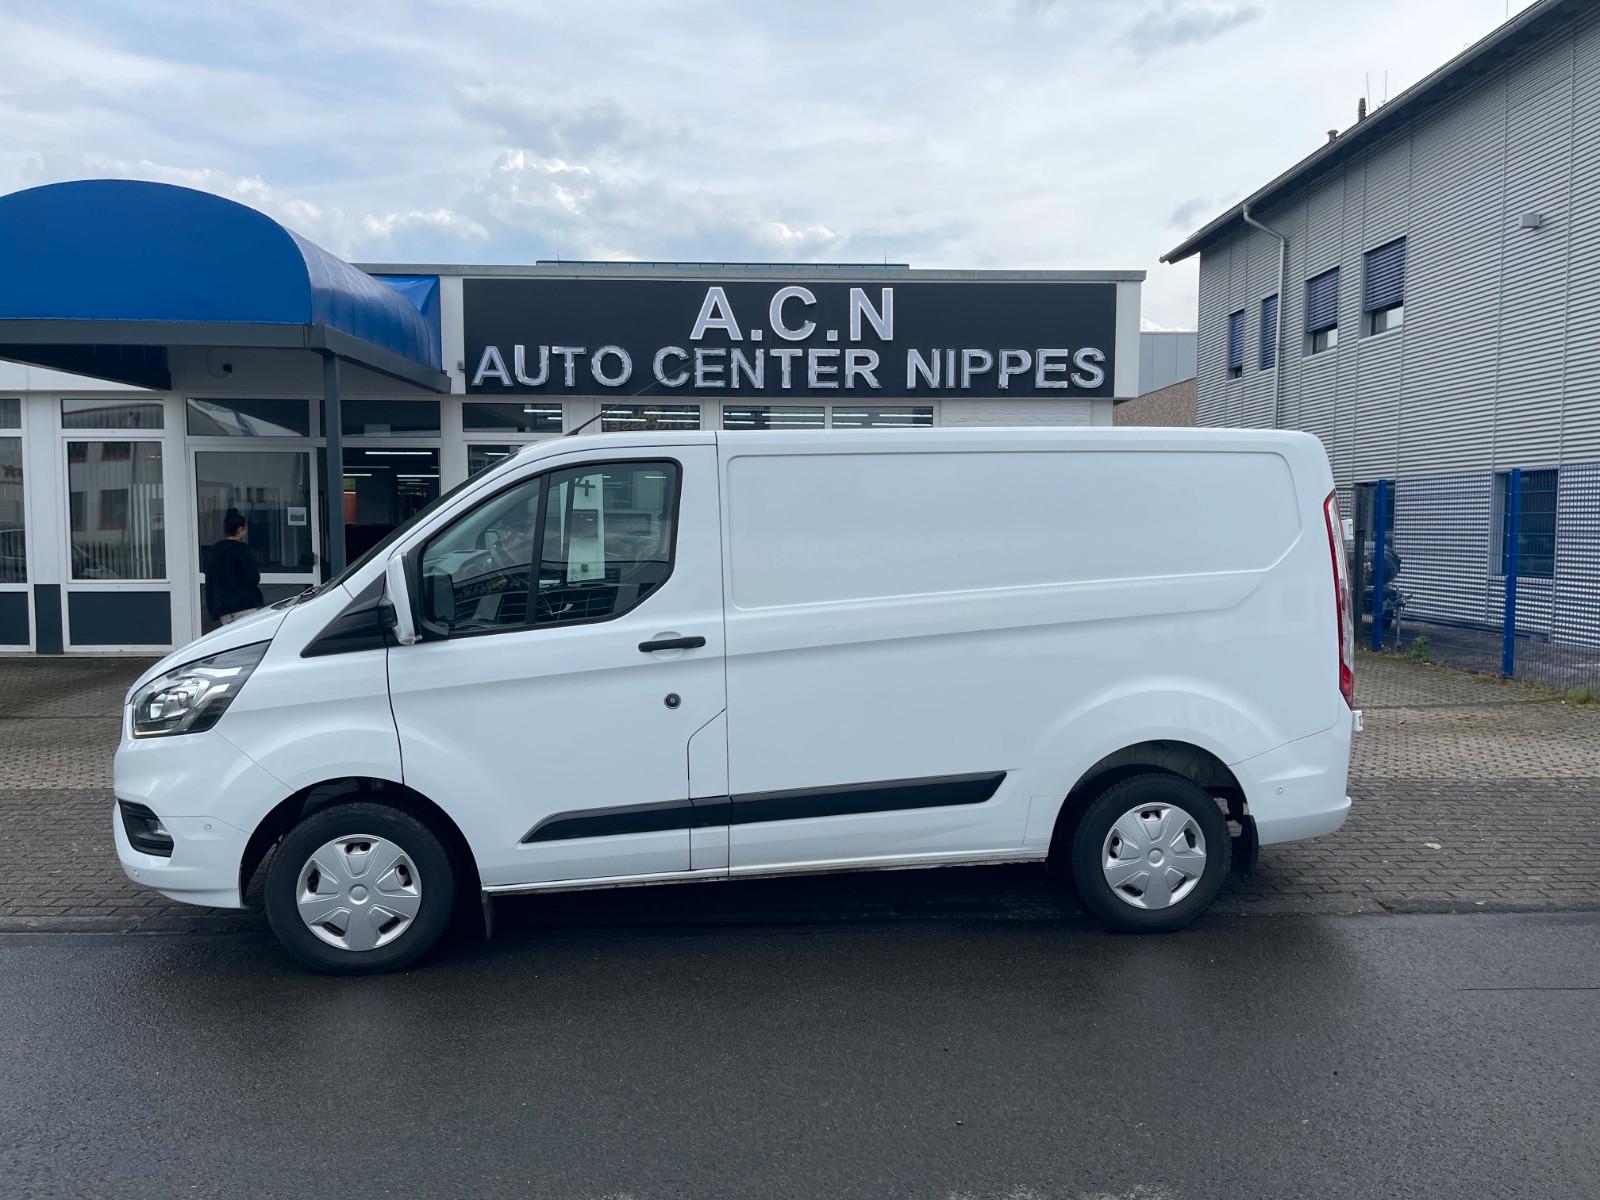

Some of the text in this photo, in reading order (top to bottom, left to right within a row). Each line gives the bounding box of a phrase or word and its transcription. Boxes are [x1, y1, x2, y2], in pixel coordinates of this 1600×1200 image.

[689, 286, 894, 342] A.C.N
[471, 344, 1106, 389] AUTO CENTER NIPPES
